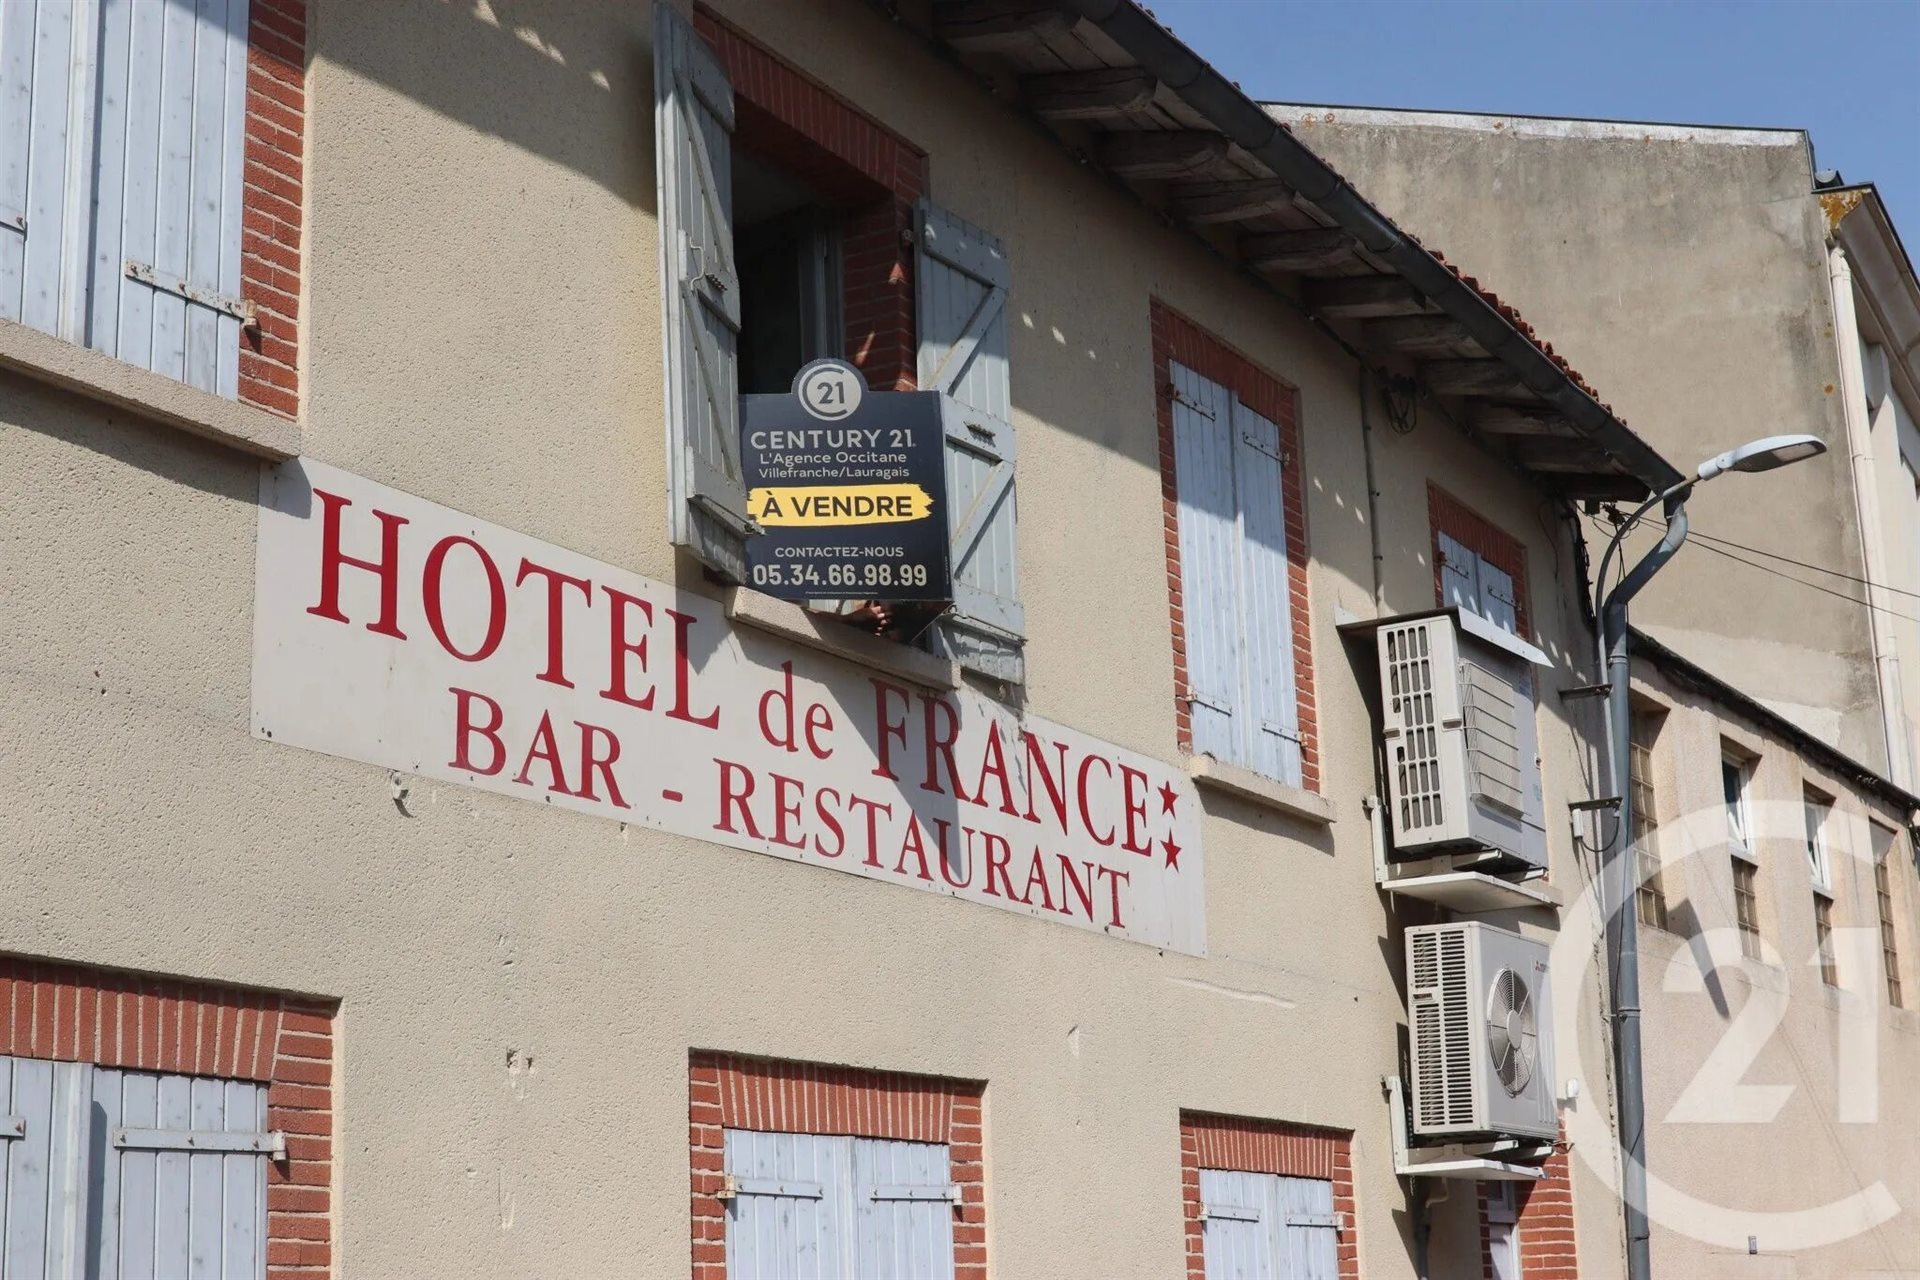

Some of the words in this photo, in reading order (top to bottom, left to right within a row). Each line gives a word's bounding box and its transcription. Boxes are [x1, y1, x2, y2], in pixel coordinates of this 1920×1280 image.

[750, 429, 882, 449] CENTURY
[889, 428, 913, 448] 21
[760, 452, 832, 467] L'Agence
[835, 451, 907, 464] Occitane
[758, 466, 910, 479] Villefranche/Lauragais
[761, 490, 784, 518] À
[791, 496, 913, 518] VENDRE
[774, 546, 905, 558] CONTACTEZ-NOUS
[752, 563, 928, 587] 05.34.66.98.99
[306, 487, 720, 730] HOTEL
[758, 660, 834, 760] de
[869, 677, 1152, 857] FRANCE
[447, 686, 631, 809] BAR
[712, 757, 1130, 929] RESTAURANT
